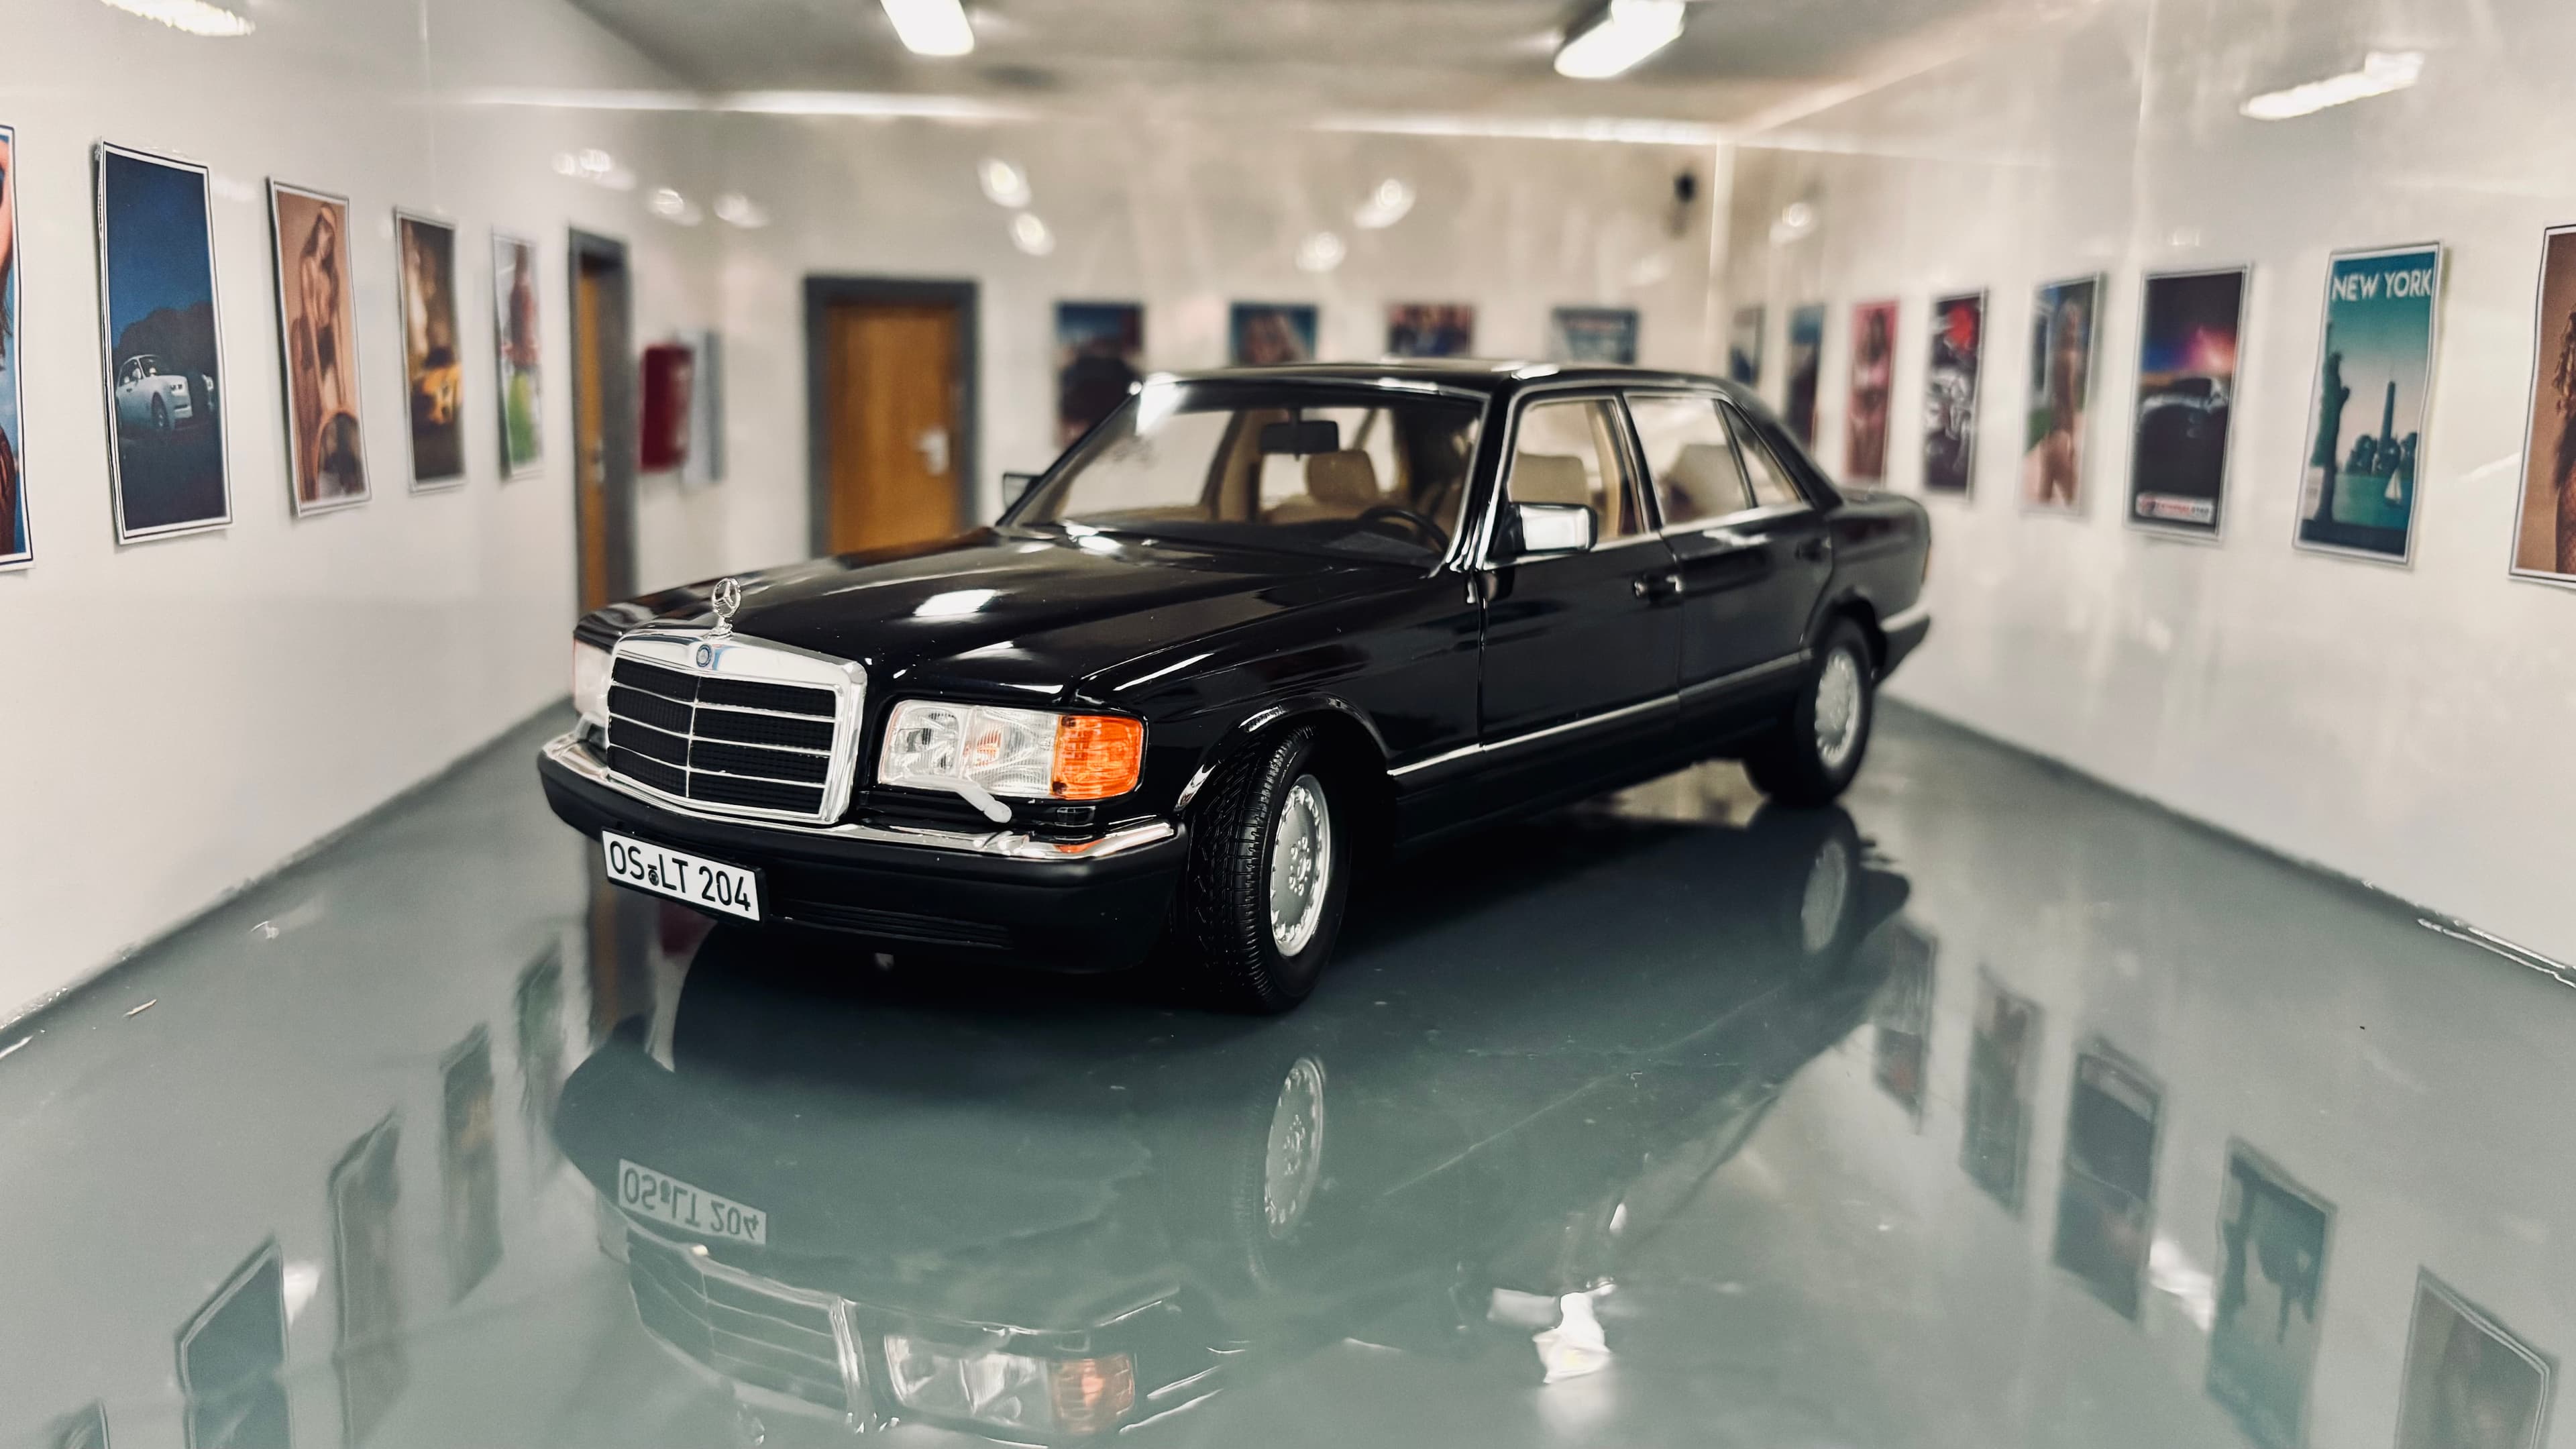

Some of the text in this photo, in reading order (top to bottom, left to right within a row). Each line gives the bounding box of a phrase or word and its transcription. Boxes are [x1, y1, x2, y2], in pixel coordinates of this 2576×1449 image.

[2332, 269, 2432, 301] NEW YORK
[699, 866, 751, 911] 204
